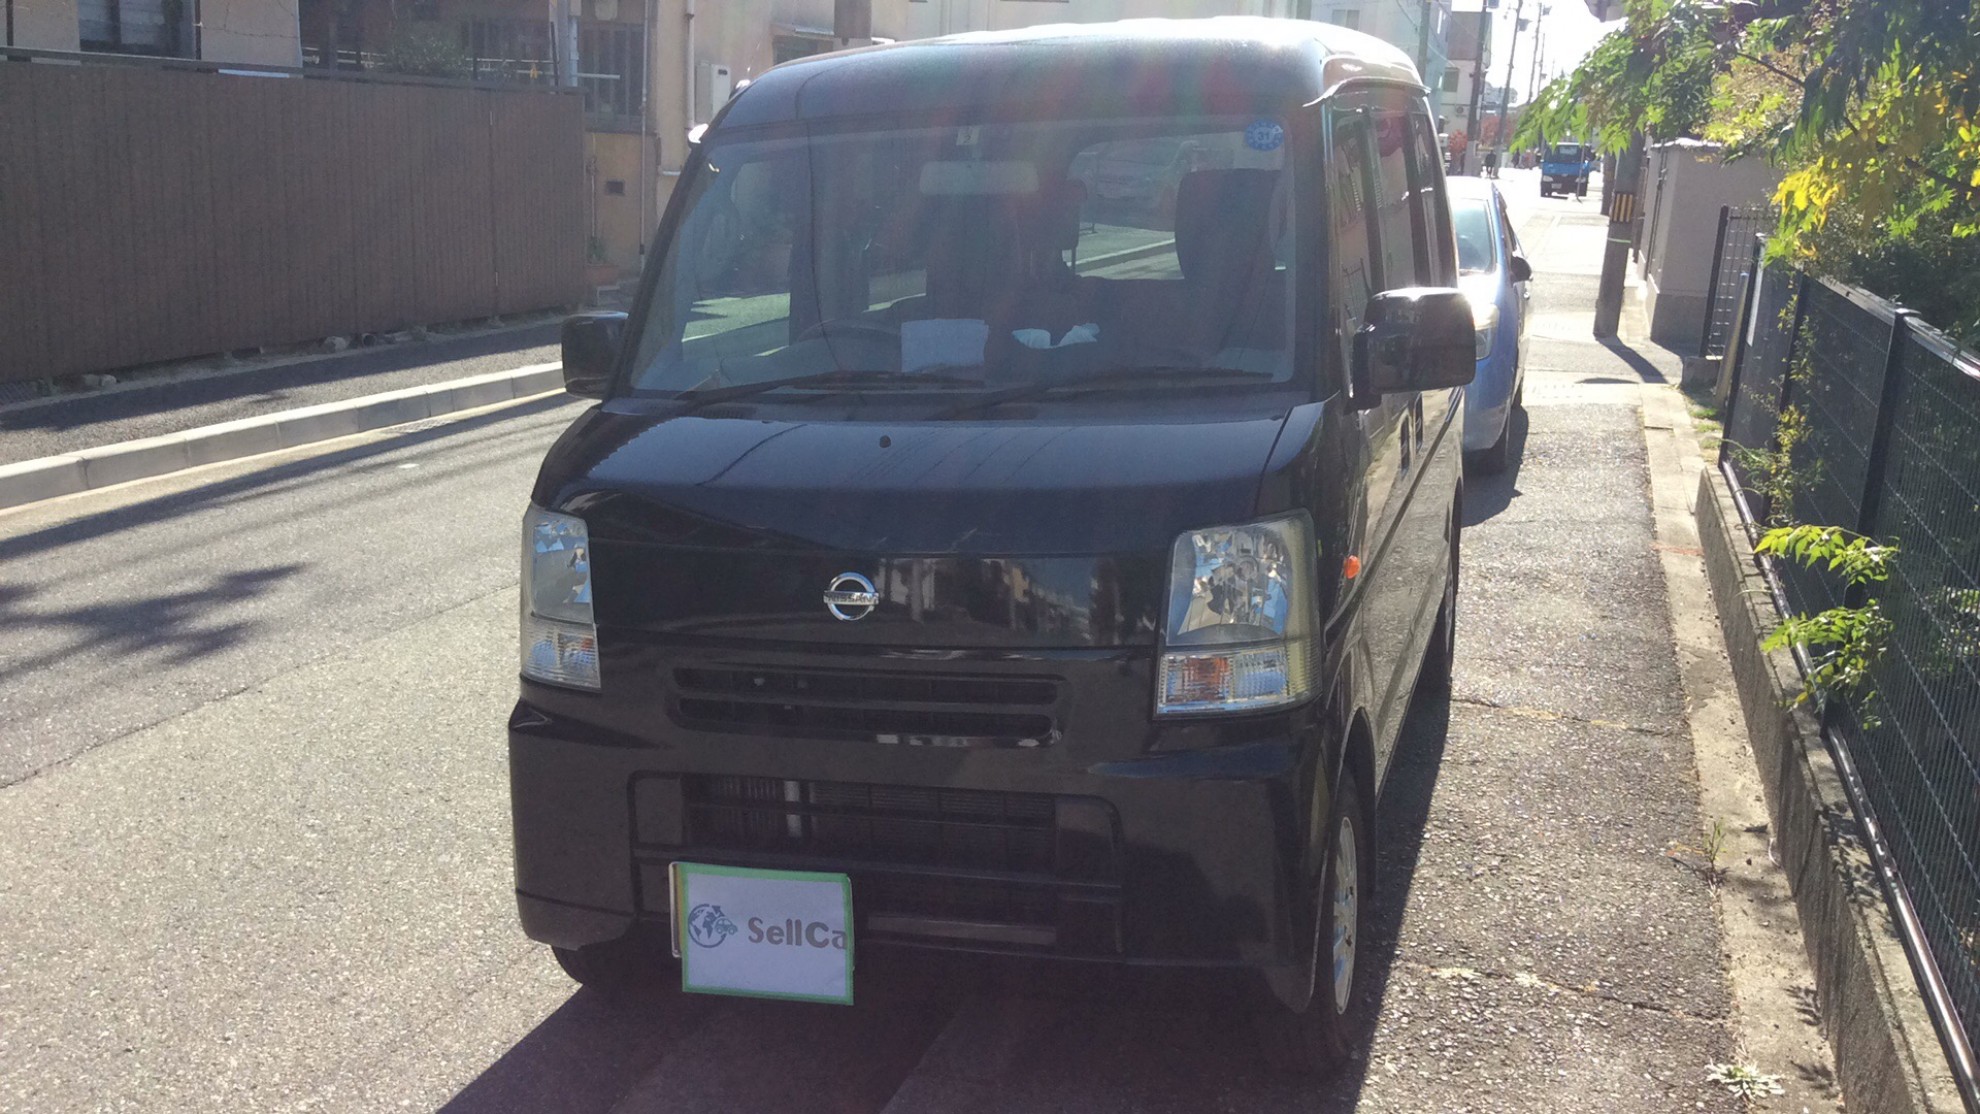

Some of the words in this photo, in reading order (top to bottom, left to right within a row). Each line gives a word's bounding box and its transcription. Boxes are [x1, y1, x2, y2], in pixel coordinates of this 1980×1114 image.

[1257, 131, 1270, 141] 31
[828, 593, 875, 604] NISSAN
[748, 916, 847, 950] SellCa
